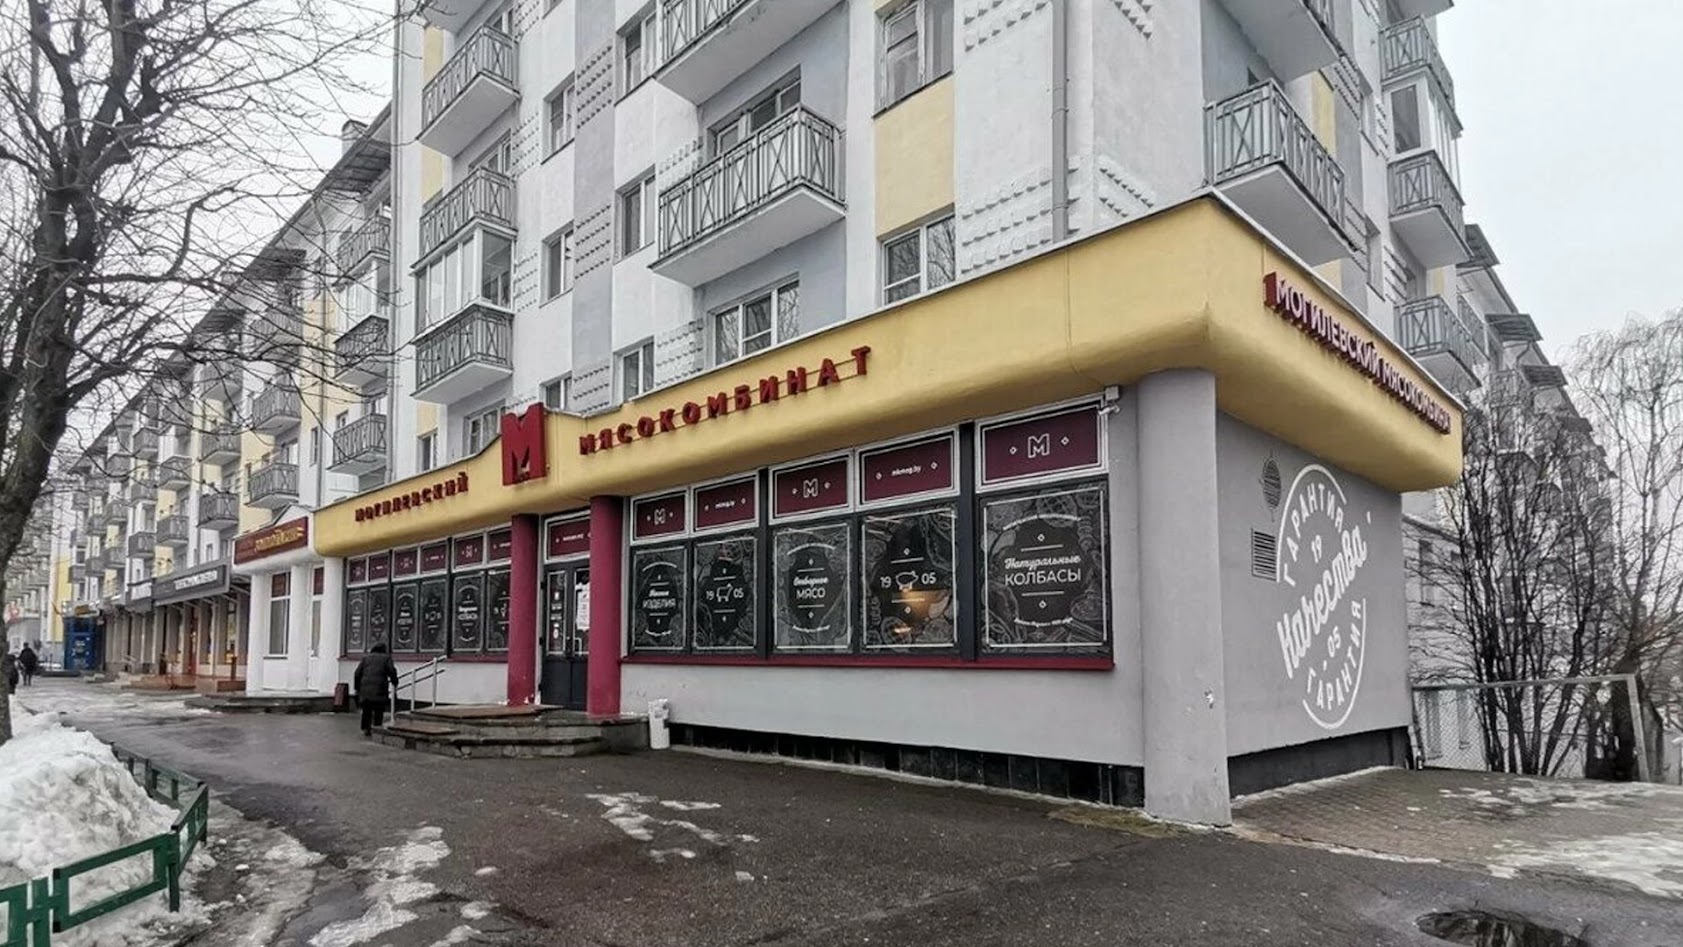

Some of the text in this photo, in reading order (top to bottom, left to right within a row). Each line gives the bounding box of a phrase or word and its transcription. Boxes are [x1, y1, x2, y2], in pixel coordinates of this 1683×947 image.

[580, 345, 871, 456] МЯСОКОМБИНАТ
[1284, 483, 1344, 587] ГАРАНТИЯ
[1311, 534, 1322, 564] 19
[1004, 555, 1081, 571] Натуральные
[1004, 568, 1081, 586] КОЛБАСЫ
[796, 587, 826, 599] МЯСО
[880, 571, 937, 588] 19 05
[1307, 600, 1361, 711] ГАРАНТИЯ
[1327, 626, 1341, 658] 05
